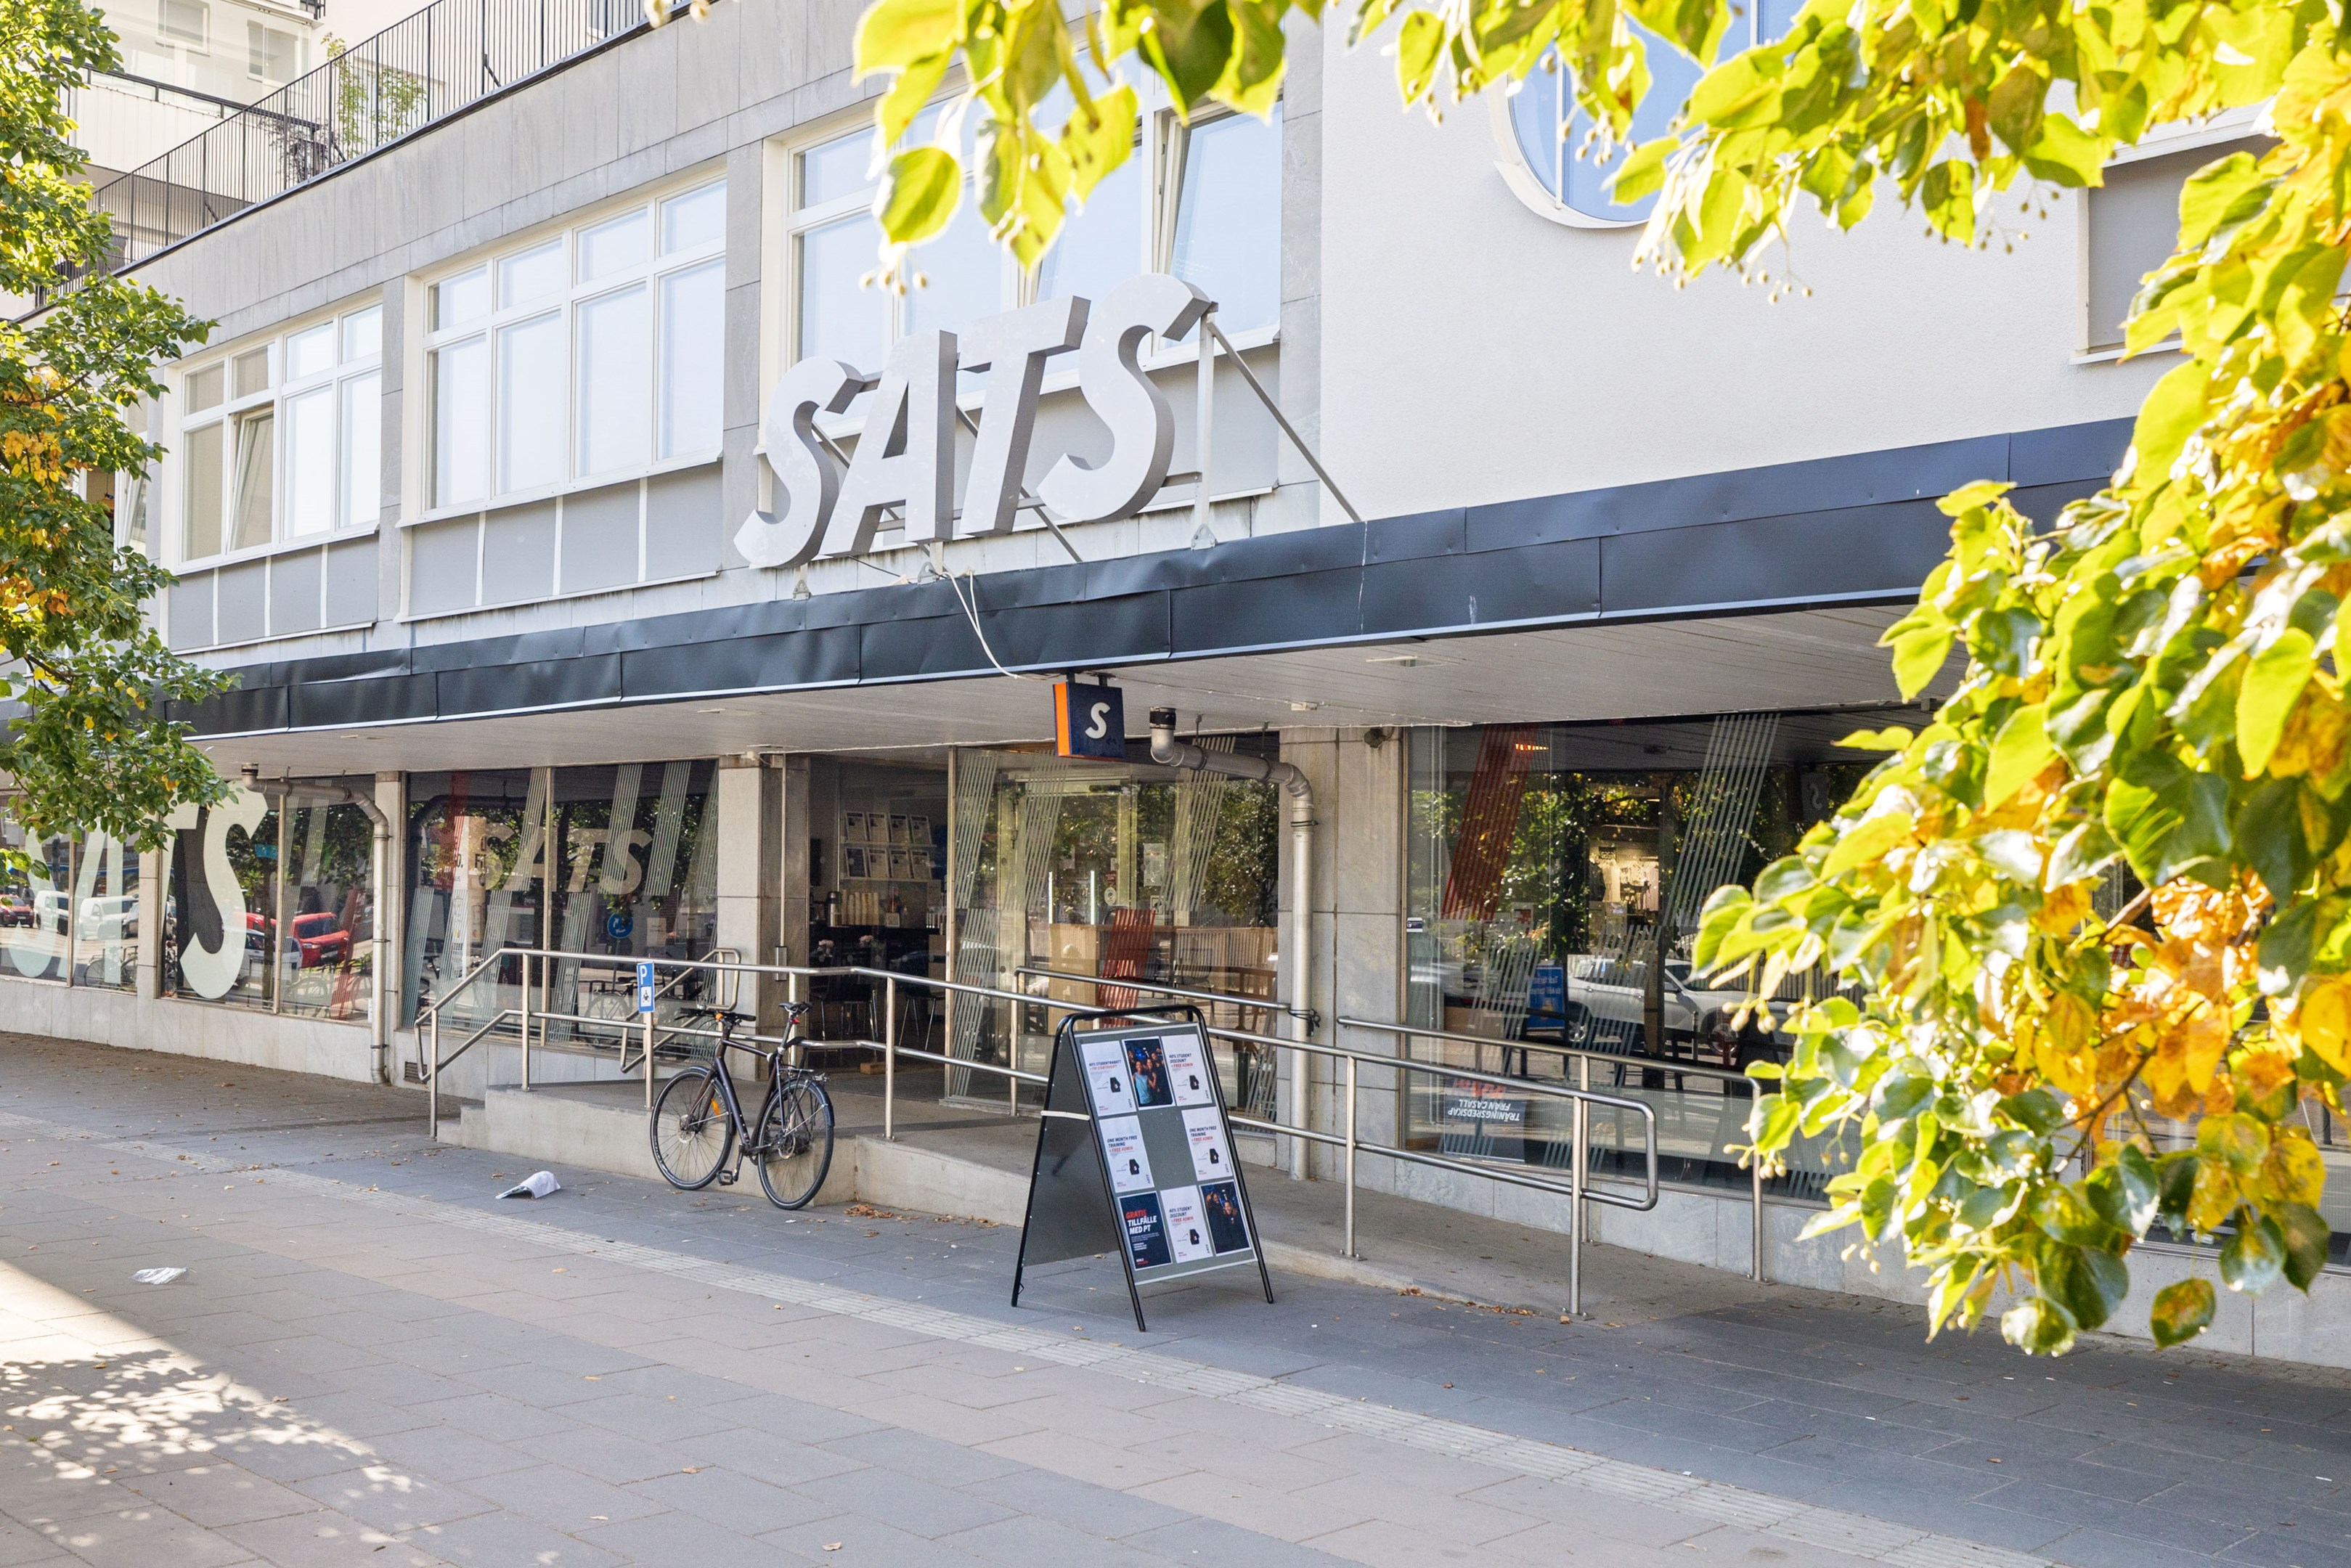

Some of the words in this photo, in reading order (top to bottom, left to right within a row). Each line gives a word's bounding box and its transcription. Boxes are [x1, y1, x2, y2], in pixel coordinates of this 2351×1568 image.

[733, 272, 1210, 569] SATS
[1085, 702, 1111, 739] S
[640, 965, 648, 985] P
[1459, 1099, 1488, 1109] CASALL
[1488, 1101, 1511, 1112] FRÅN
[1448, 1107, 1520, 1122] TRÄNINGSREDSKAP
[1125, 1209, 1146, 1220] GRATIS
[1128, 1215, 1157, 1227] TILLFÄLLE
